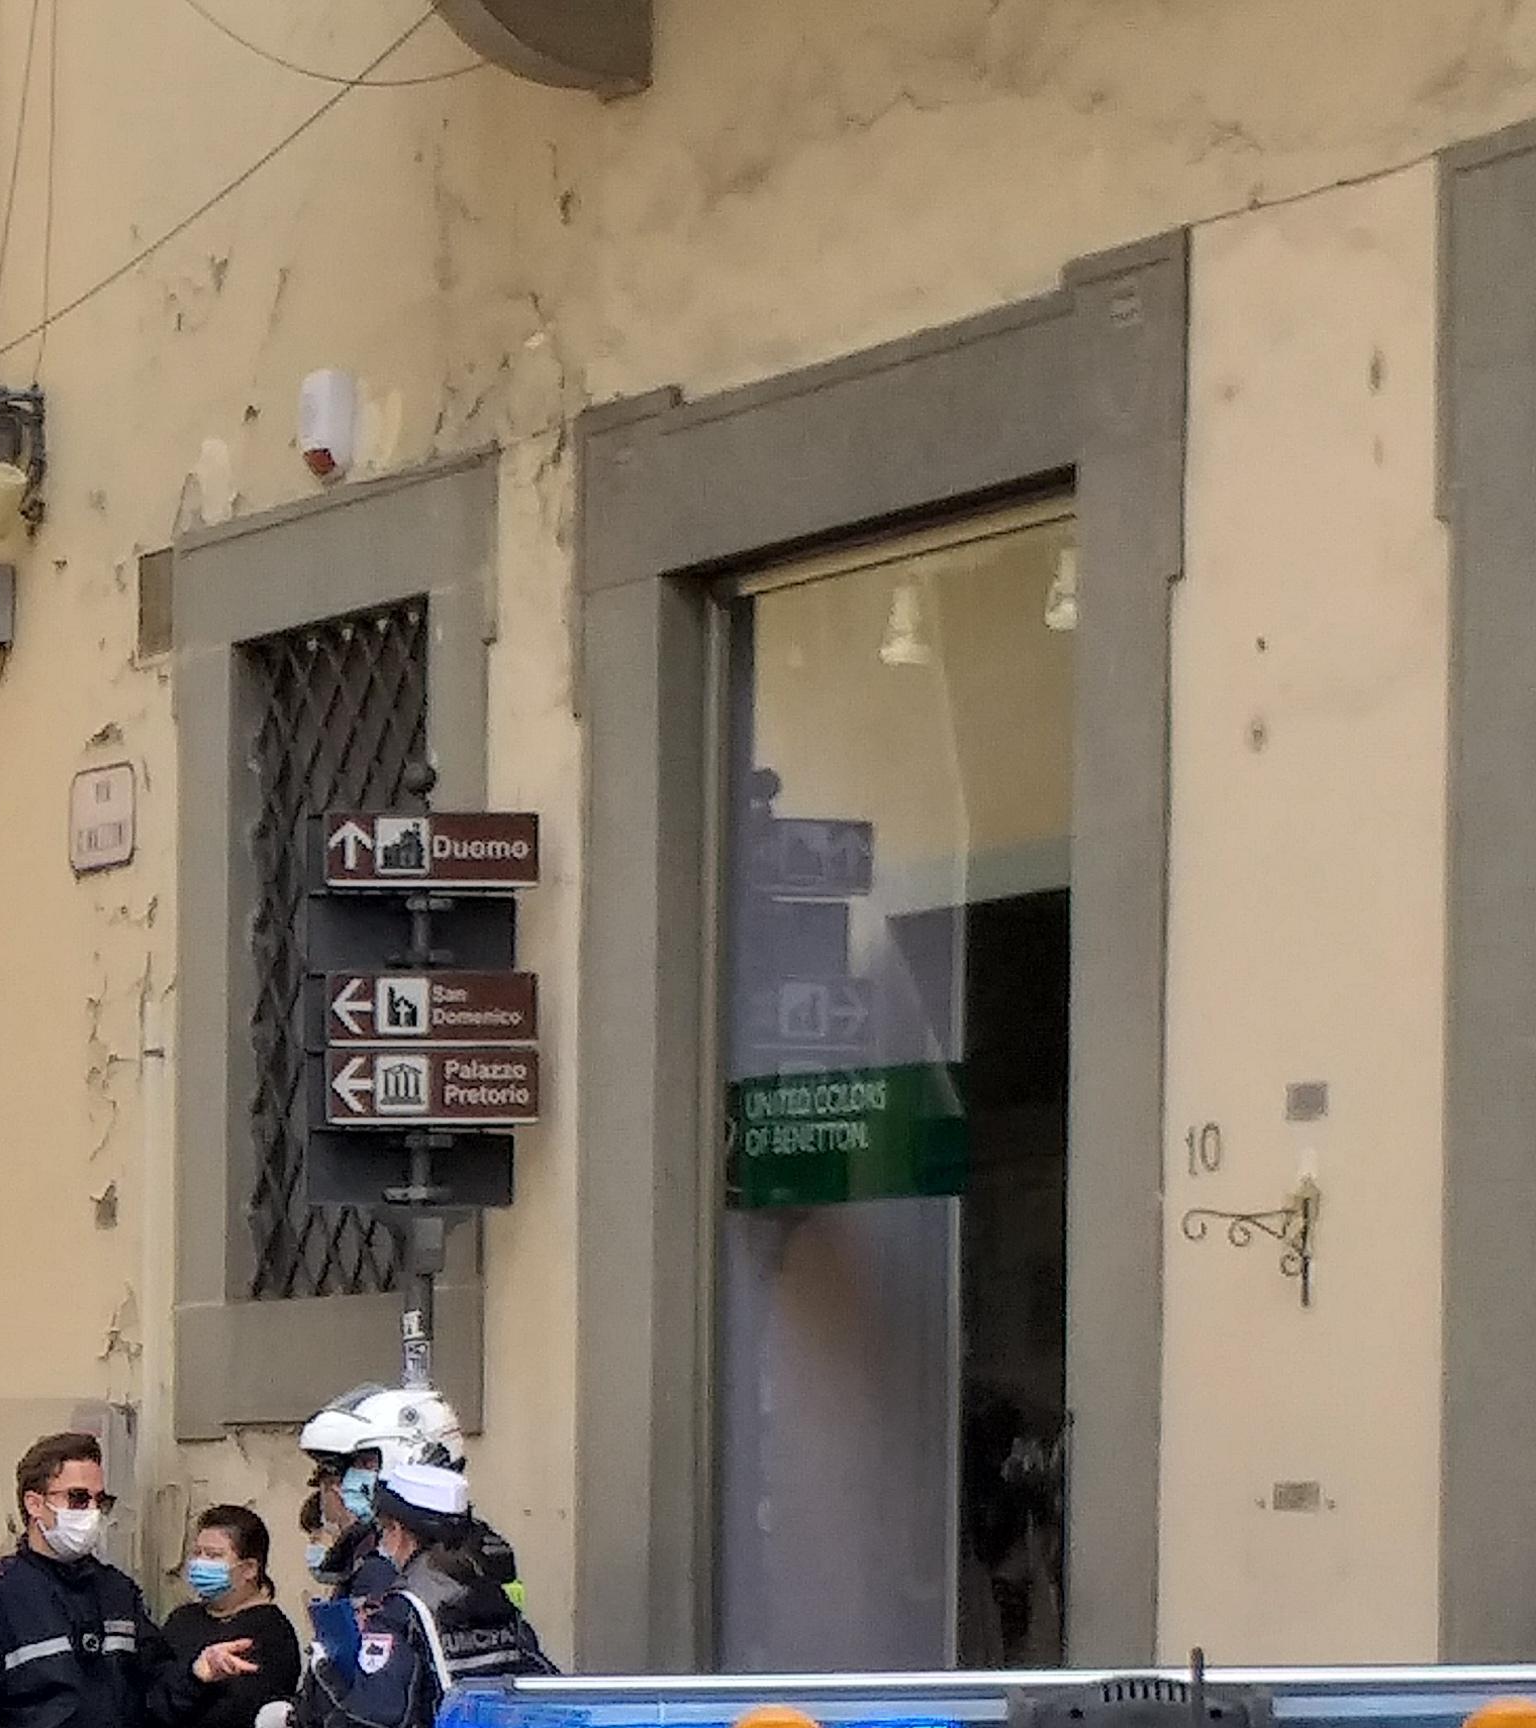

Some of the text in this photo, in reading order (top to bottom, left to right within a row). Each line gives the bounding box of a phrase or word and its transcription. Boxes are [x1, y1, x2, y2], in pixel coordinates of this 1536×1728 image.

[432, 834, 530, 861] Duomo
[432, 985, 467, 1004] San
[432, 1008, 524, 1027] Domenico
[443, 1059, 528, 1082] Palazzo
[443, 1084, 530, 1106] Pretorio
[745, 1080, 887, 1119] UNITED COLORS
[1185, 1121, 1222, 1176] 10
